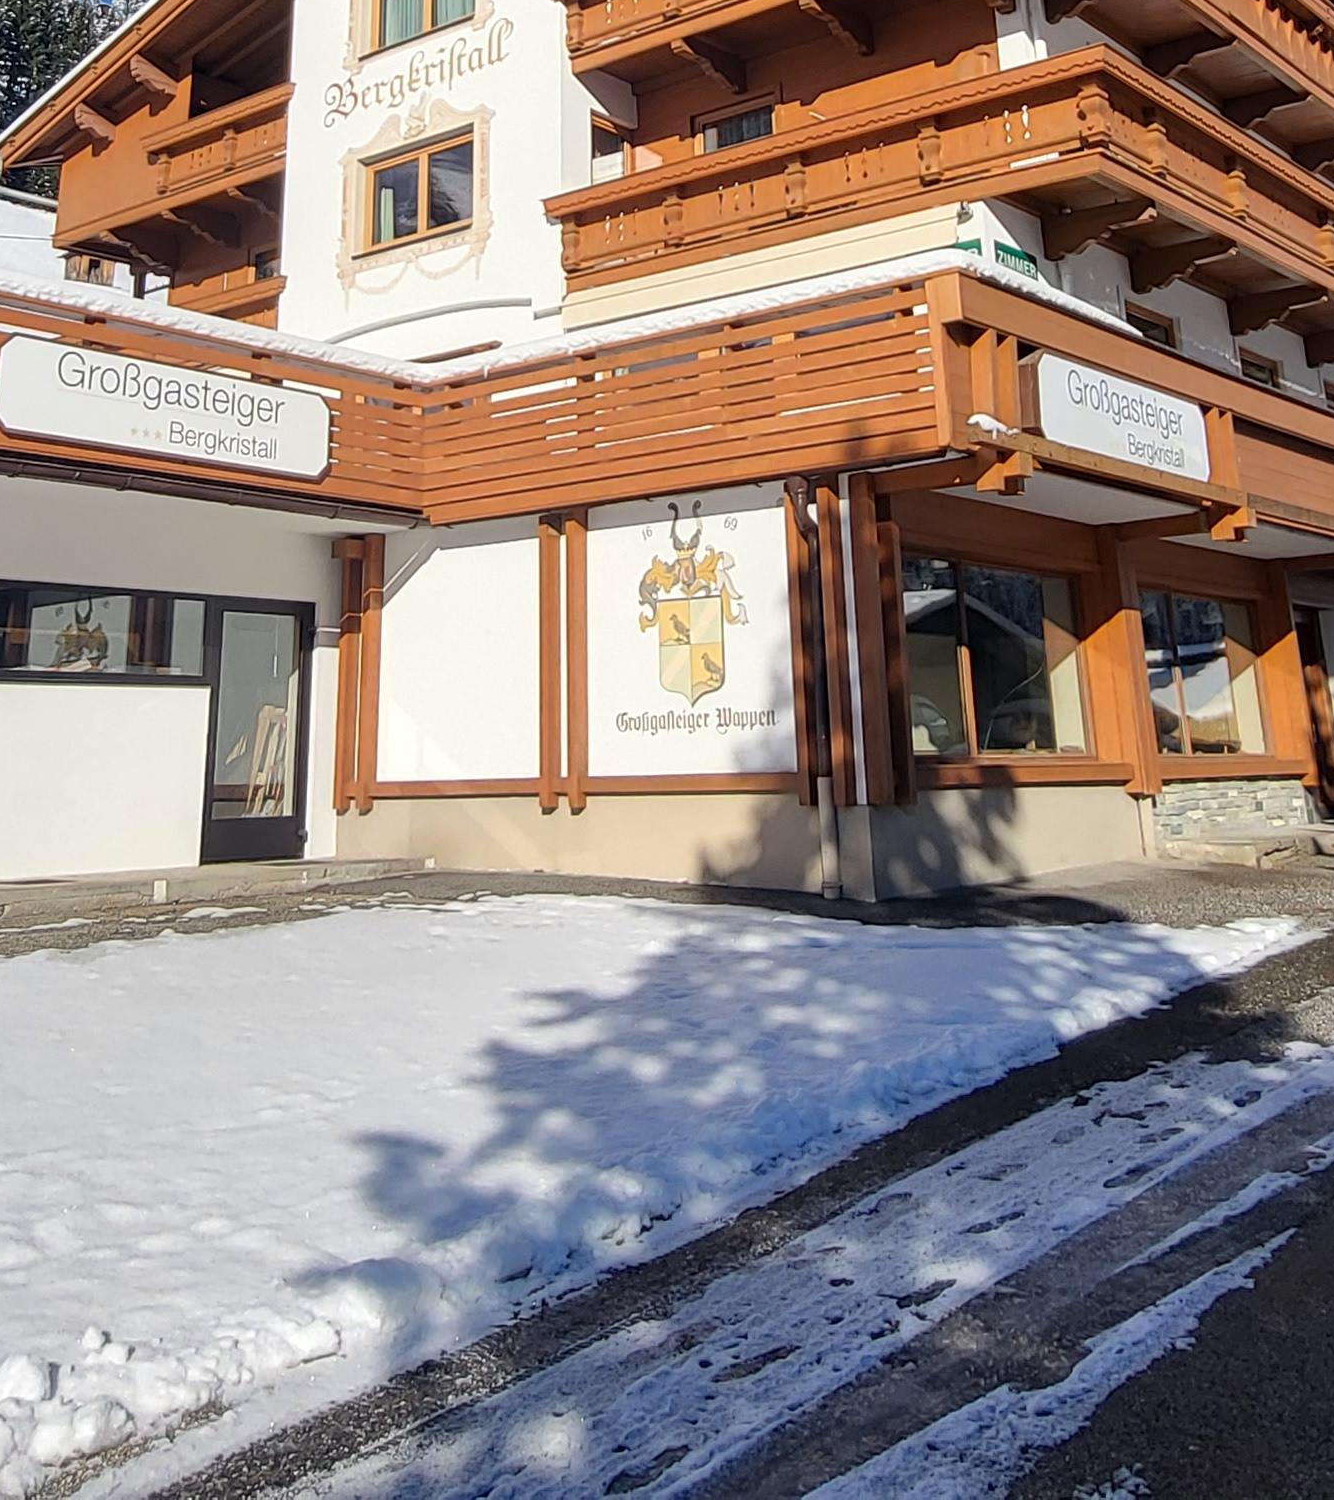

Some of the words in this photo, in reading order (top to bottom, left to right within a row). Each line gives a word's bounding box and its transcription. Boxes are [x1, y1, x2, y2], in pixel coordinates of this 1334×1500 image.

[997, 249, 1038, 279] ZIMMER
[57, 350, 285, 427] Großgasteiger
[1067, 369, 1183, 439] Großgasteiger
[168, 421, 278, 460] Bergkristall
[1127, 433, 1185, 468] Bergkristall
[642, 526, 653, 540] 16
[724, 516, 738, 531] 69
[715, 707, 778, 735] Wappen
